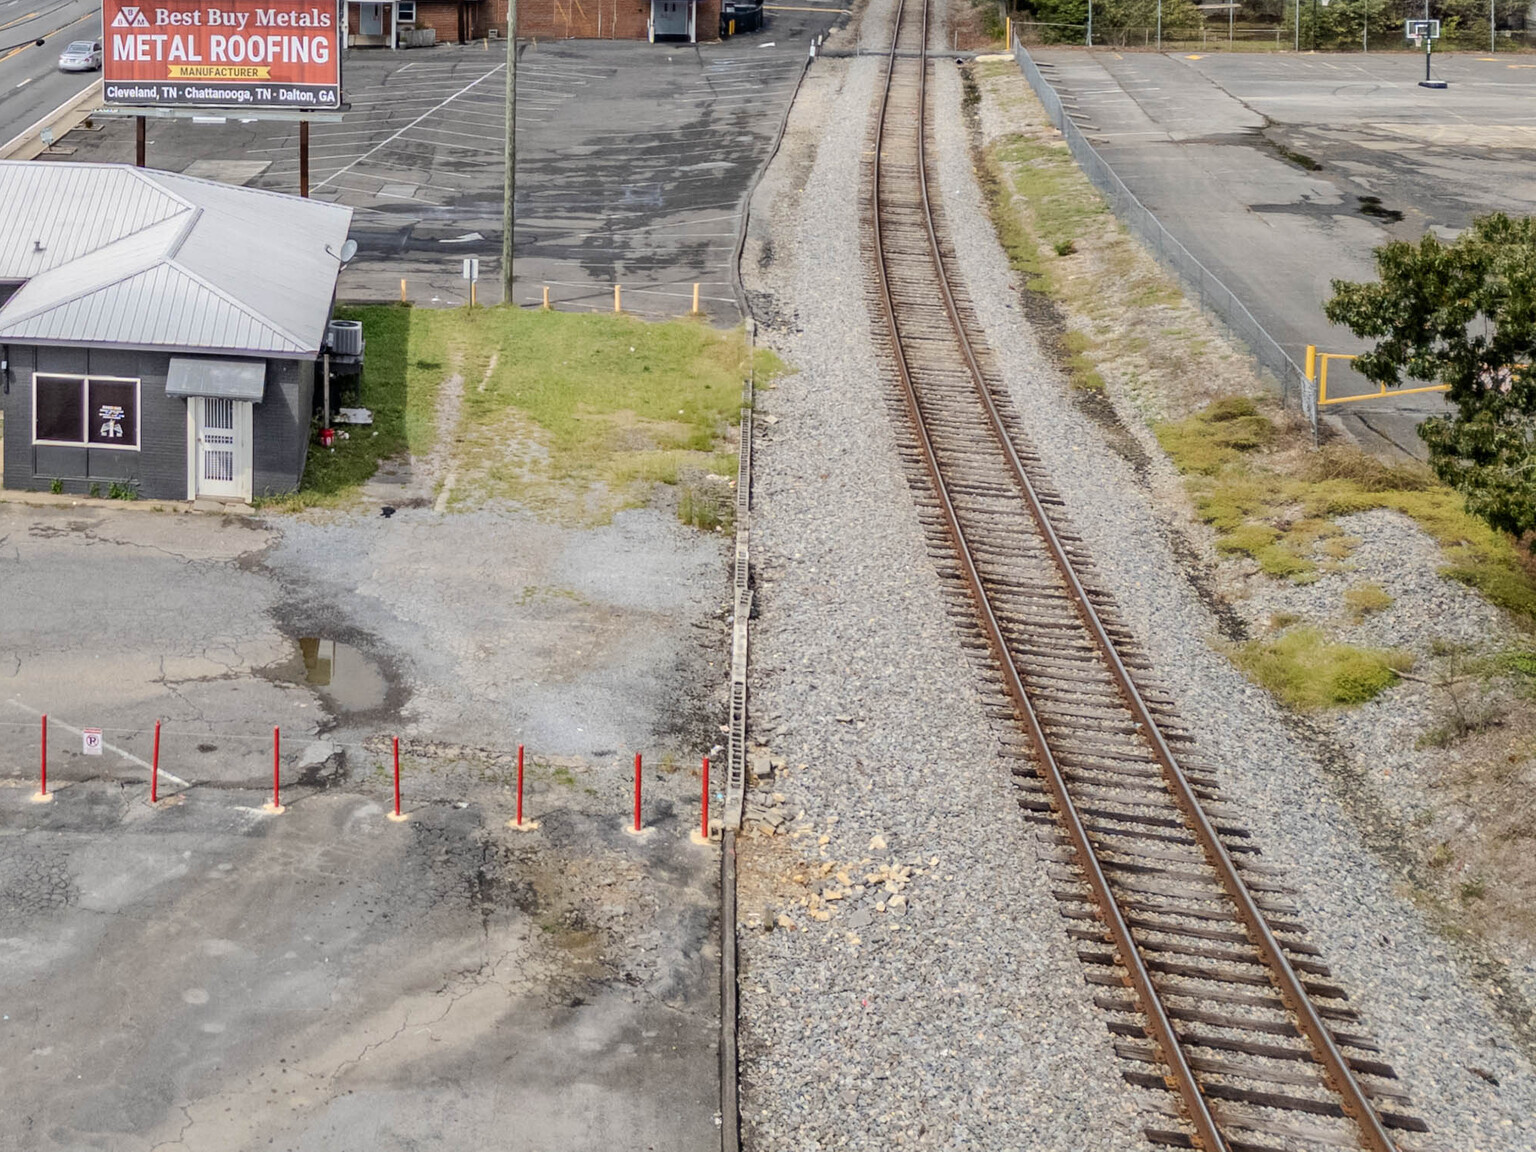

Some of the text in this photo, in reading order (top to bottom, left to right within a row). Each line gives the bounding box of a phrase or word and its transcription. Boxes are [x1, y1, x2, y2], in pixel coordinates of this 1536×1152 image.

[155, 8, 332, 31] Best Buy Metals
[113, 34, 330, 63] METAL ROOFING
[179, 66, 259, 77] MANUFACTURER
[107, 86, 336, 103] Cleveland, TN Chattanooga, TN Dalton, GA
